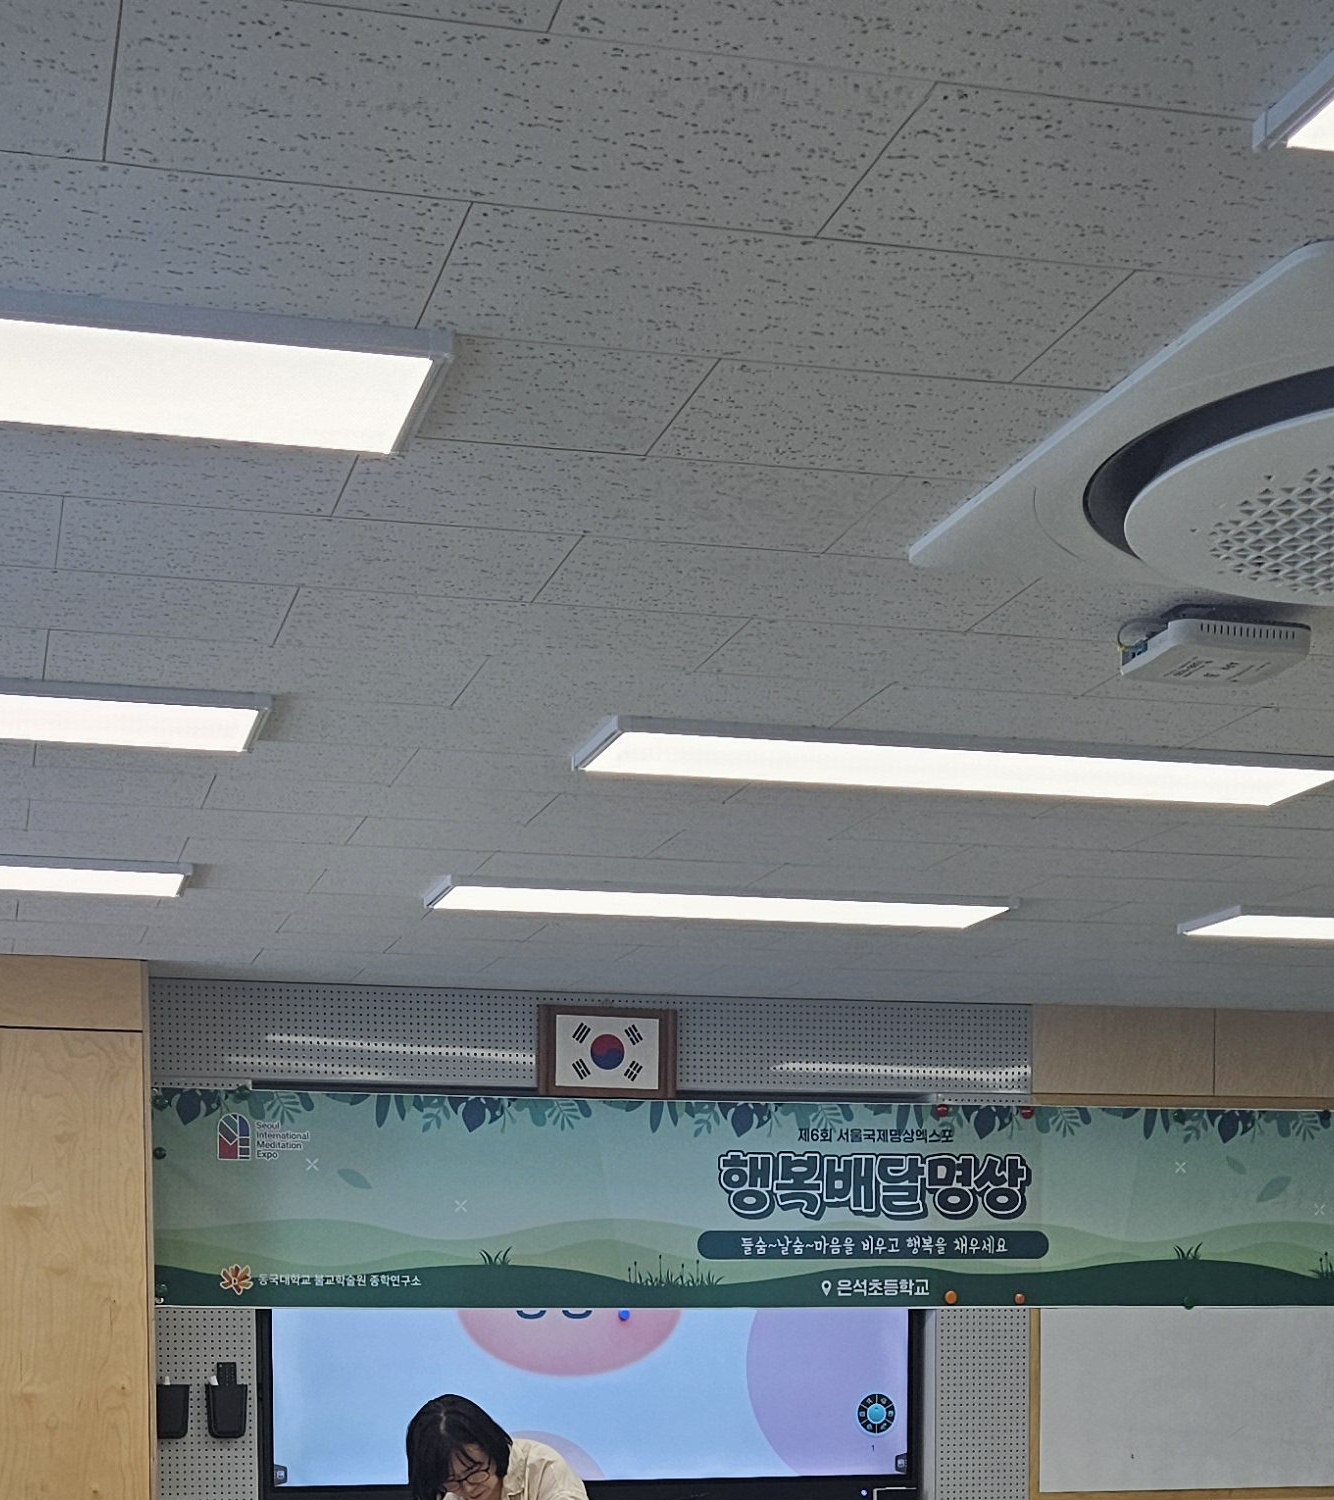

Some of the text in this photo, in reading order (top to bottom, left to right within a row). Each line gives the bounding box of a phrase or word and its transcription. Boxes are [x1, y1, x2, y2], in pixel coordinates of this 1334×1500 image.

[256, 1121, 279, 1130] Seoul
[256, 1131, 309, 1140] International
[798, 1128, 954, 1144] 제6회 서울국제명상엑스포
[256, 1141, 302, 1150] Meditation
[256, 1151, 279, 1160] Expo
[719, 1150, 1031, 1220] 행복배달명상
[861, 1236, 900, 1255] 비우고
[906, 1235, 948, 1256] 행복을
[953, 1237, 1008, 1255] 채우세요
[258, 1274, 422, 1288] 동국대학교 불교학술원 종학연구소
[837, 1279, 930, 1297] 은석초등학교
